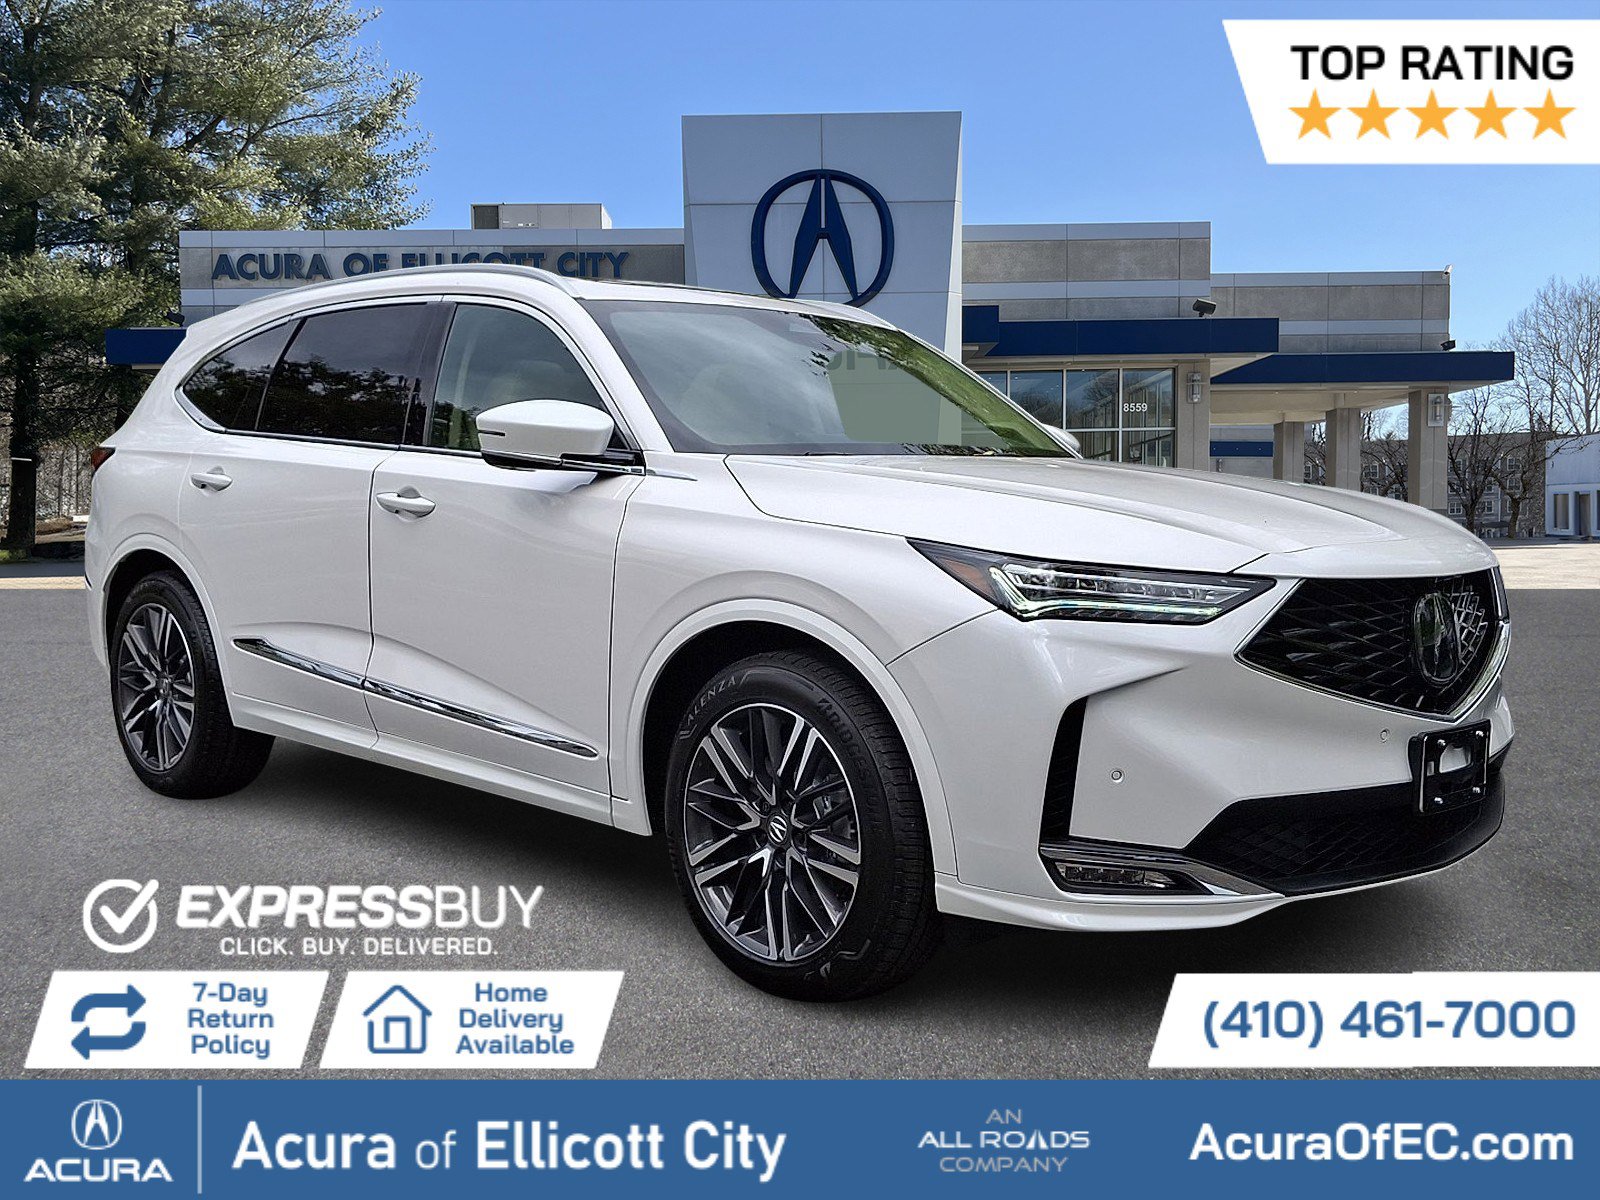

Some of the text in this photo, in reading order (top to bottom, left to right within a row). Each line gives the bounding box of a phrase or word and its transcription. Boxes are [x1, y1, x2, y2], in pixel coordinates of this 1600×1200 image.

[211, 253, 334, 281] ACURA
[343, 252, 388, 277] OF
[558, 252, 627, 279] CITY
[1123, 403, 1148, 412] 8559
